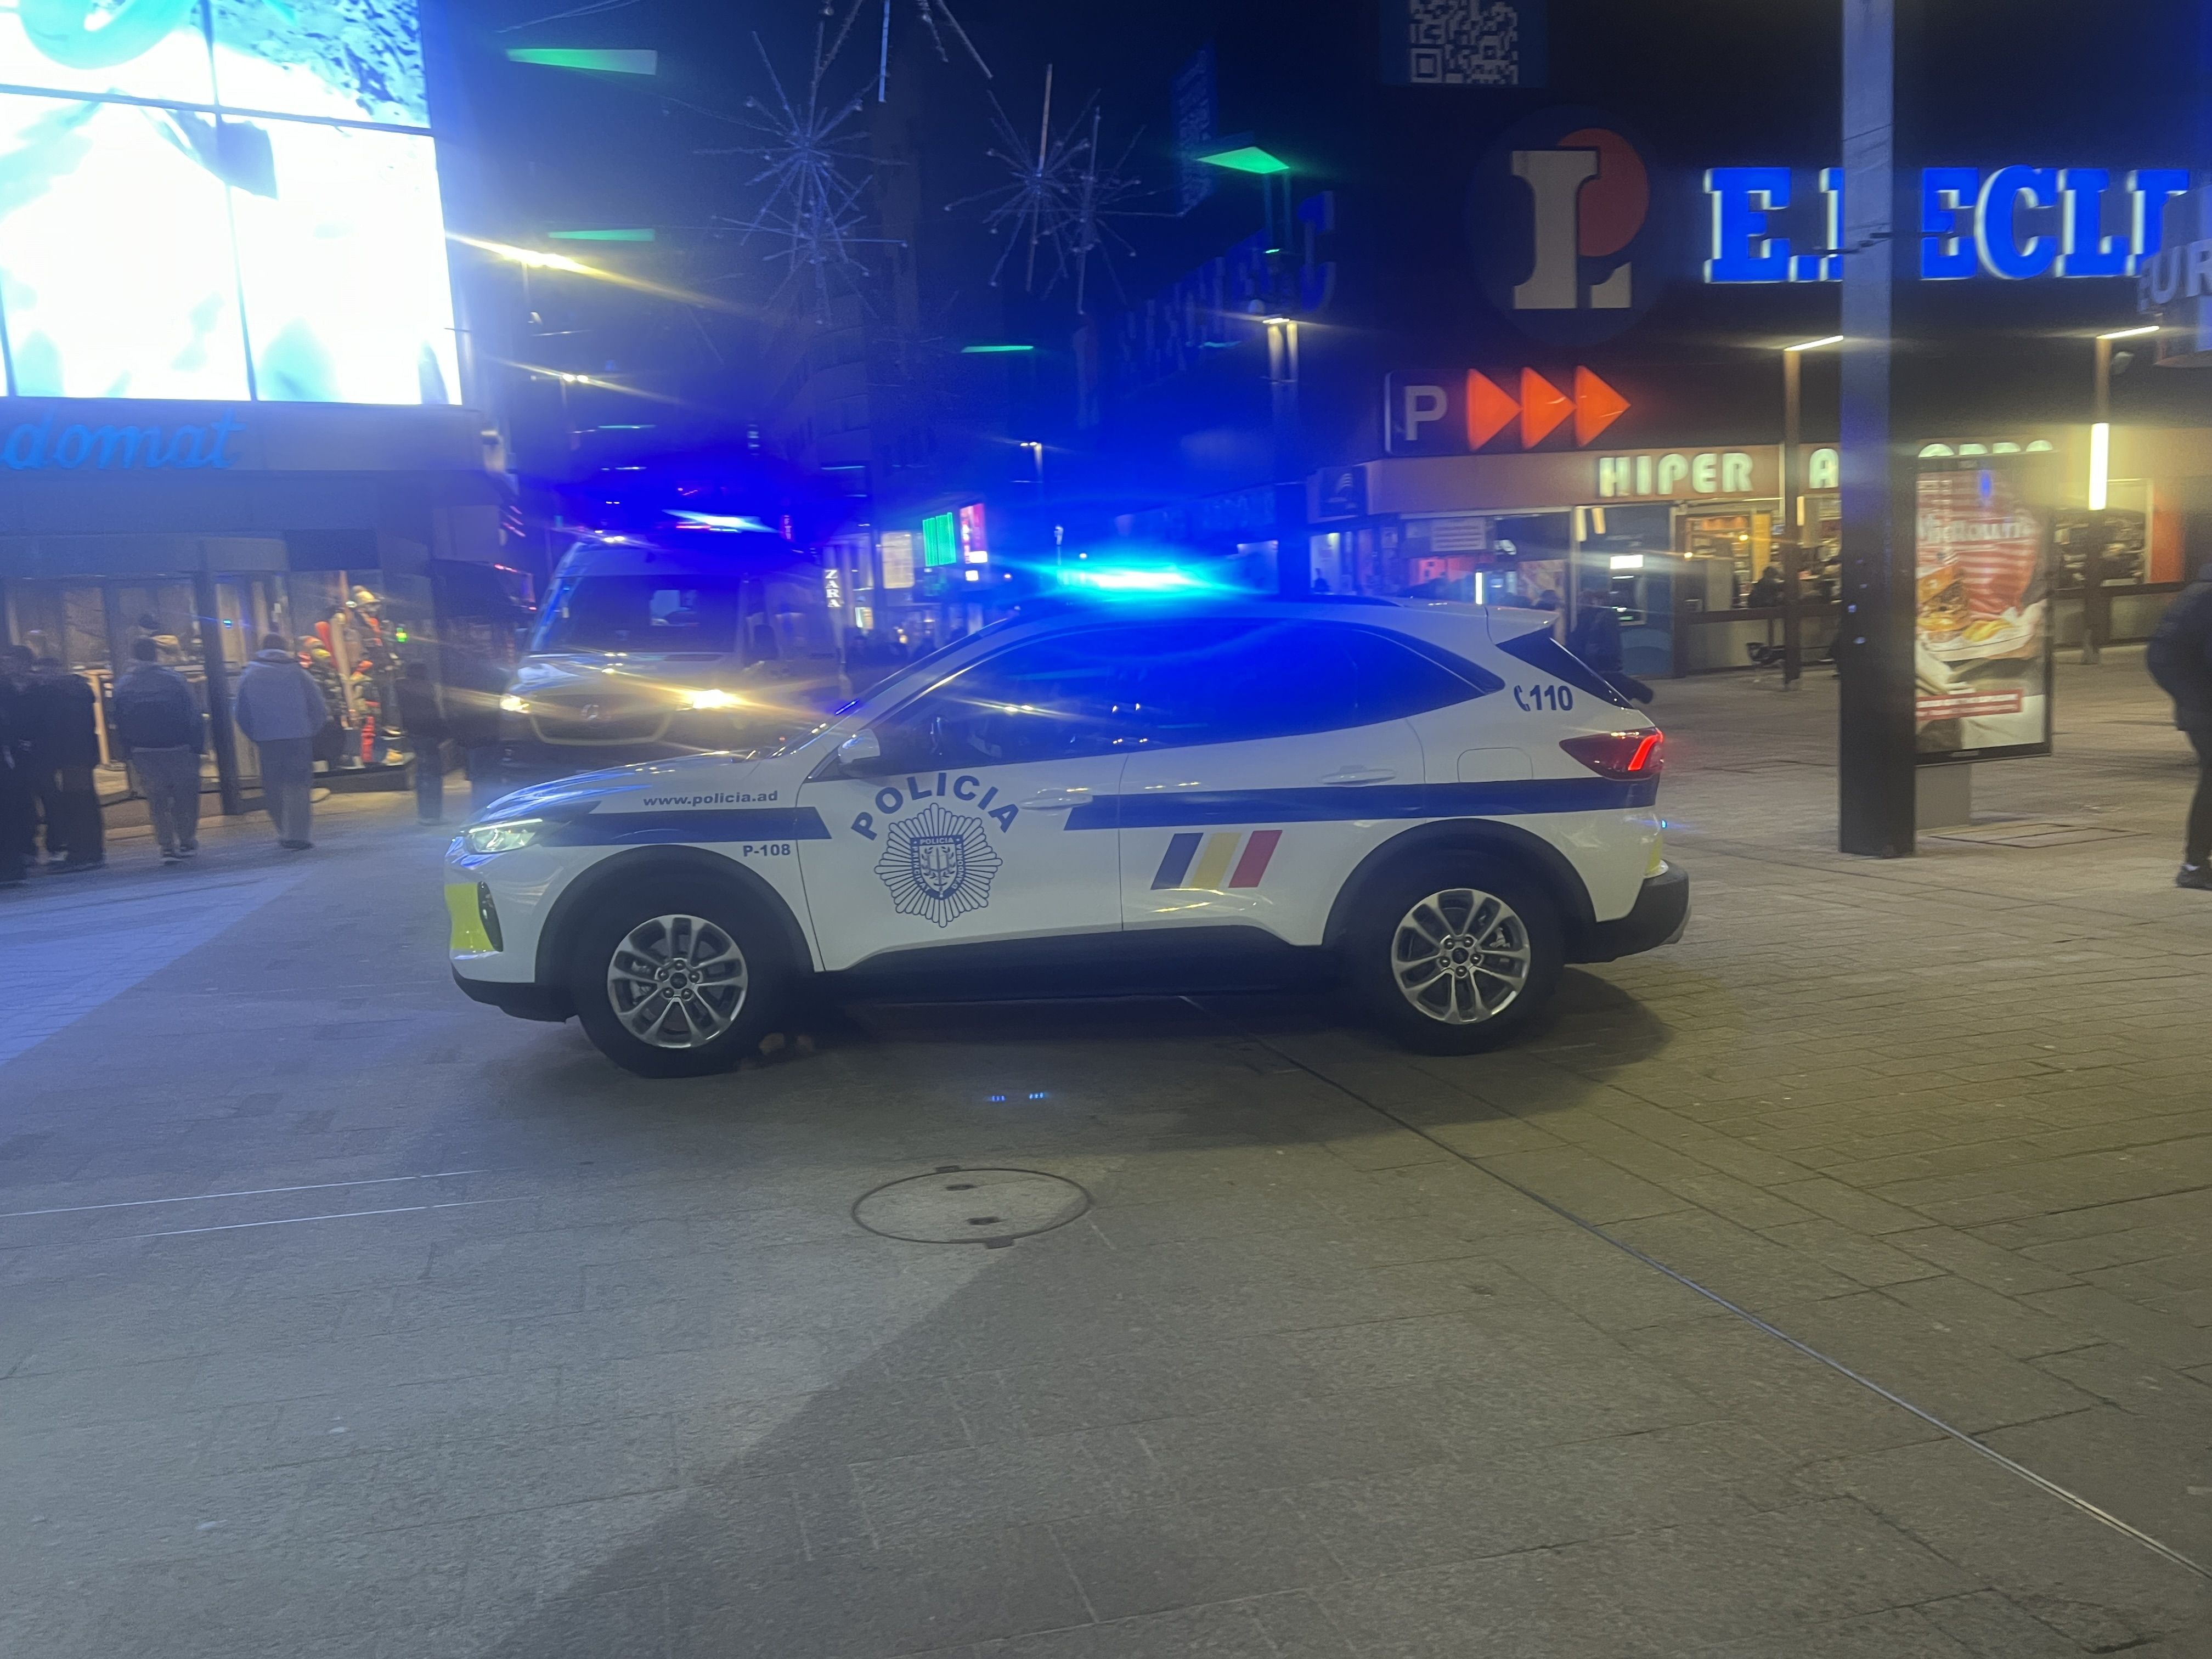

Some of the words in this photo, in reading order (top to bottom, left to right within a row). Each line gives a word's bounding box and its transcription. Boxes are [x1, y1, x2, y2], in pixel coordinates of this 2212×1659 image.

[1405, 385, 1448, 440] P
[0, 408, 247, 470] domat
[1599, 452, 1753, 497] HIPER
[825, 569, 842, 608] ZARA
[1530, 685, 1573, 711] 110
[643, 791, 778, 806] www.policia.ad
[851, 772, 1019, 841] POLICIA
[743, 844, 791, 857] P-108
